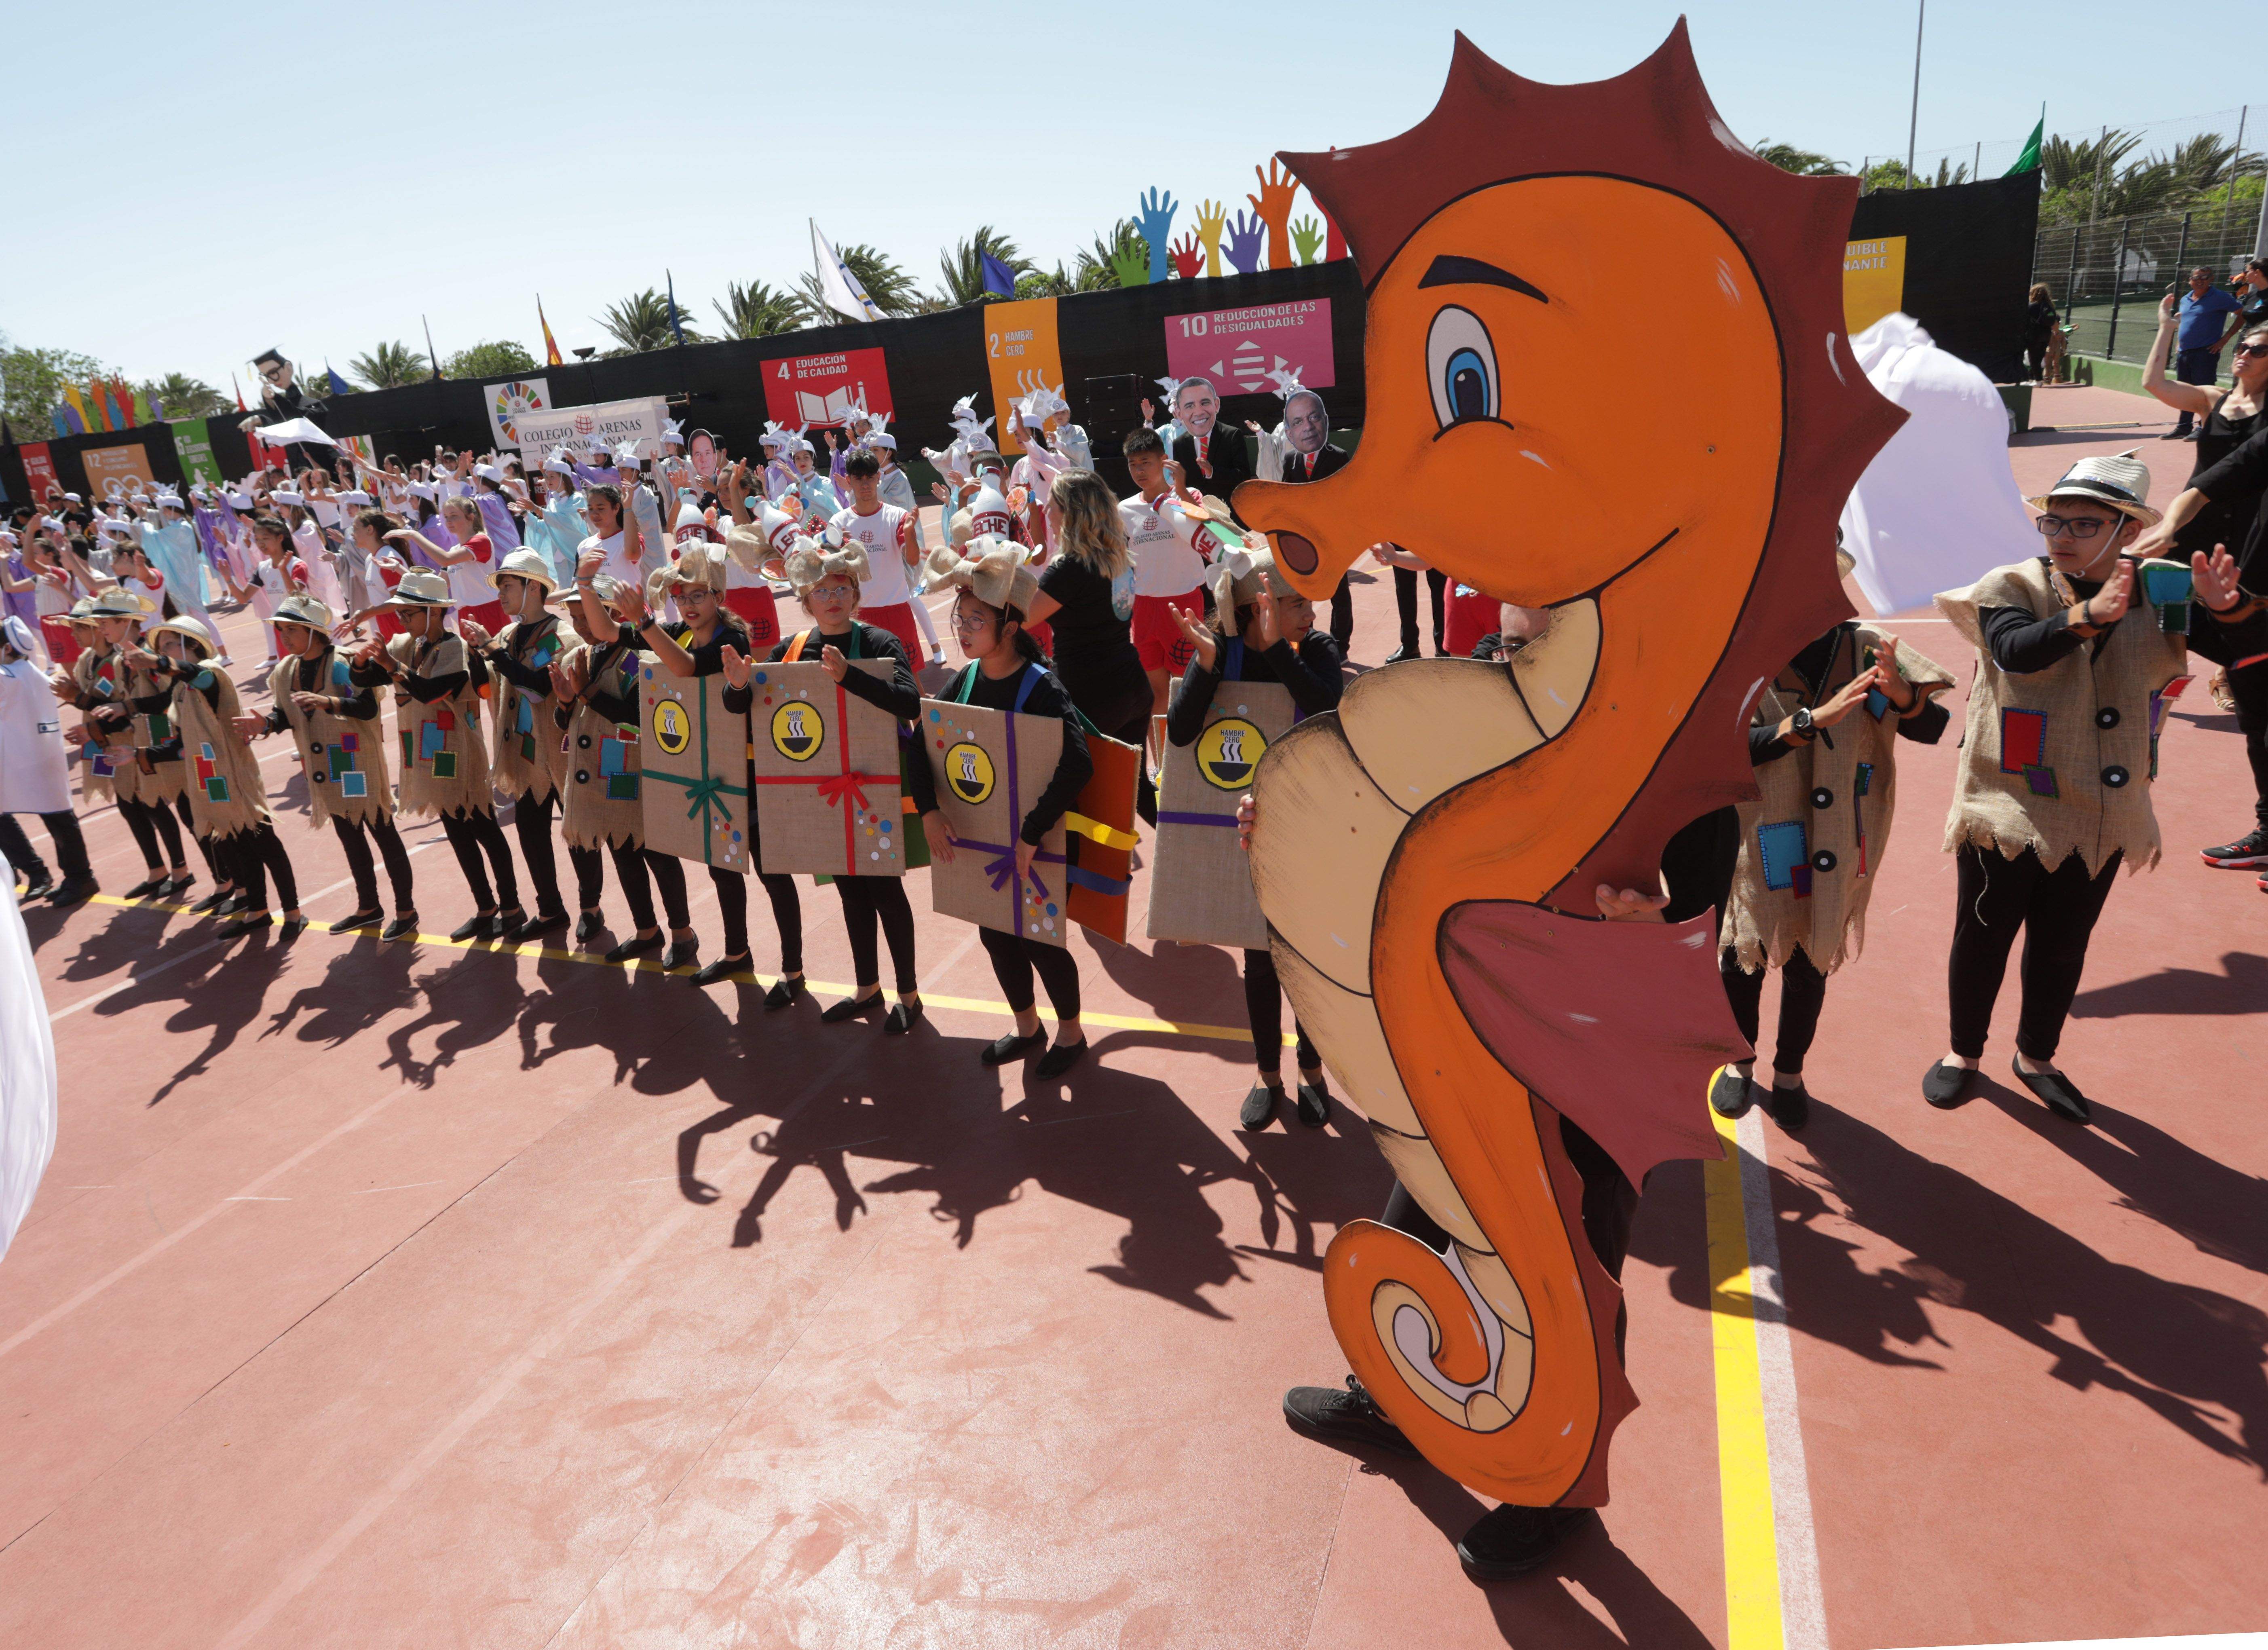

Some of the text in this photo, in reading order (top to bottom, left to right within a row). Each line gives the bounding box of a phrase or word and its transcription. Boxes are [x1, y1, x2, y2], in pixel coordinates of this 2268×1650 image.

[1214, 302, 1316, 322] REDUCCIÓN DE LAS
[1180, 315, 1208, 337] 10
[1214, 315, 1304, 334] DESIGUALDADES
[1005, 329, 1034, 342] HAMBRE
[990, 333, 1000, 358] 2
[1006, 344, 1024, 356] CERO
[796, 354, 846, 368] EDUCACIÓN
[777, 362, 790, 380] 4
[797, 365, 848, 378] DE CALIDAD
[524, 419, 642, 442] COLEGIO ARENAS
[87, 453, 101, 467] 12
[959, 752, 977, 760] HAMBRE
